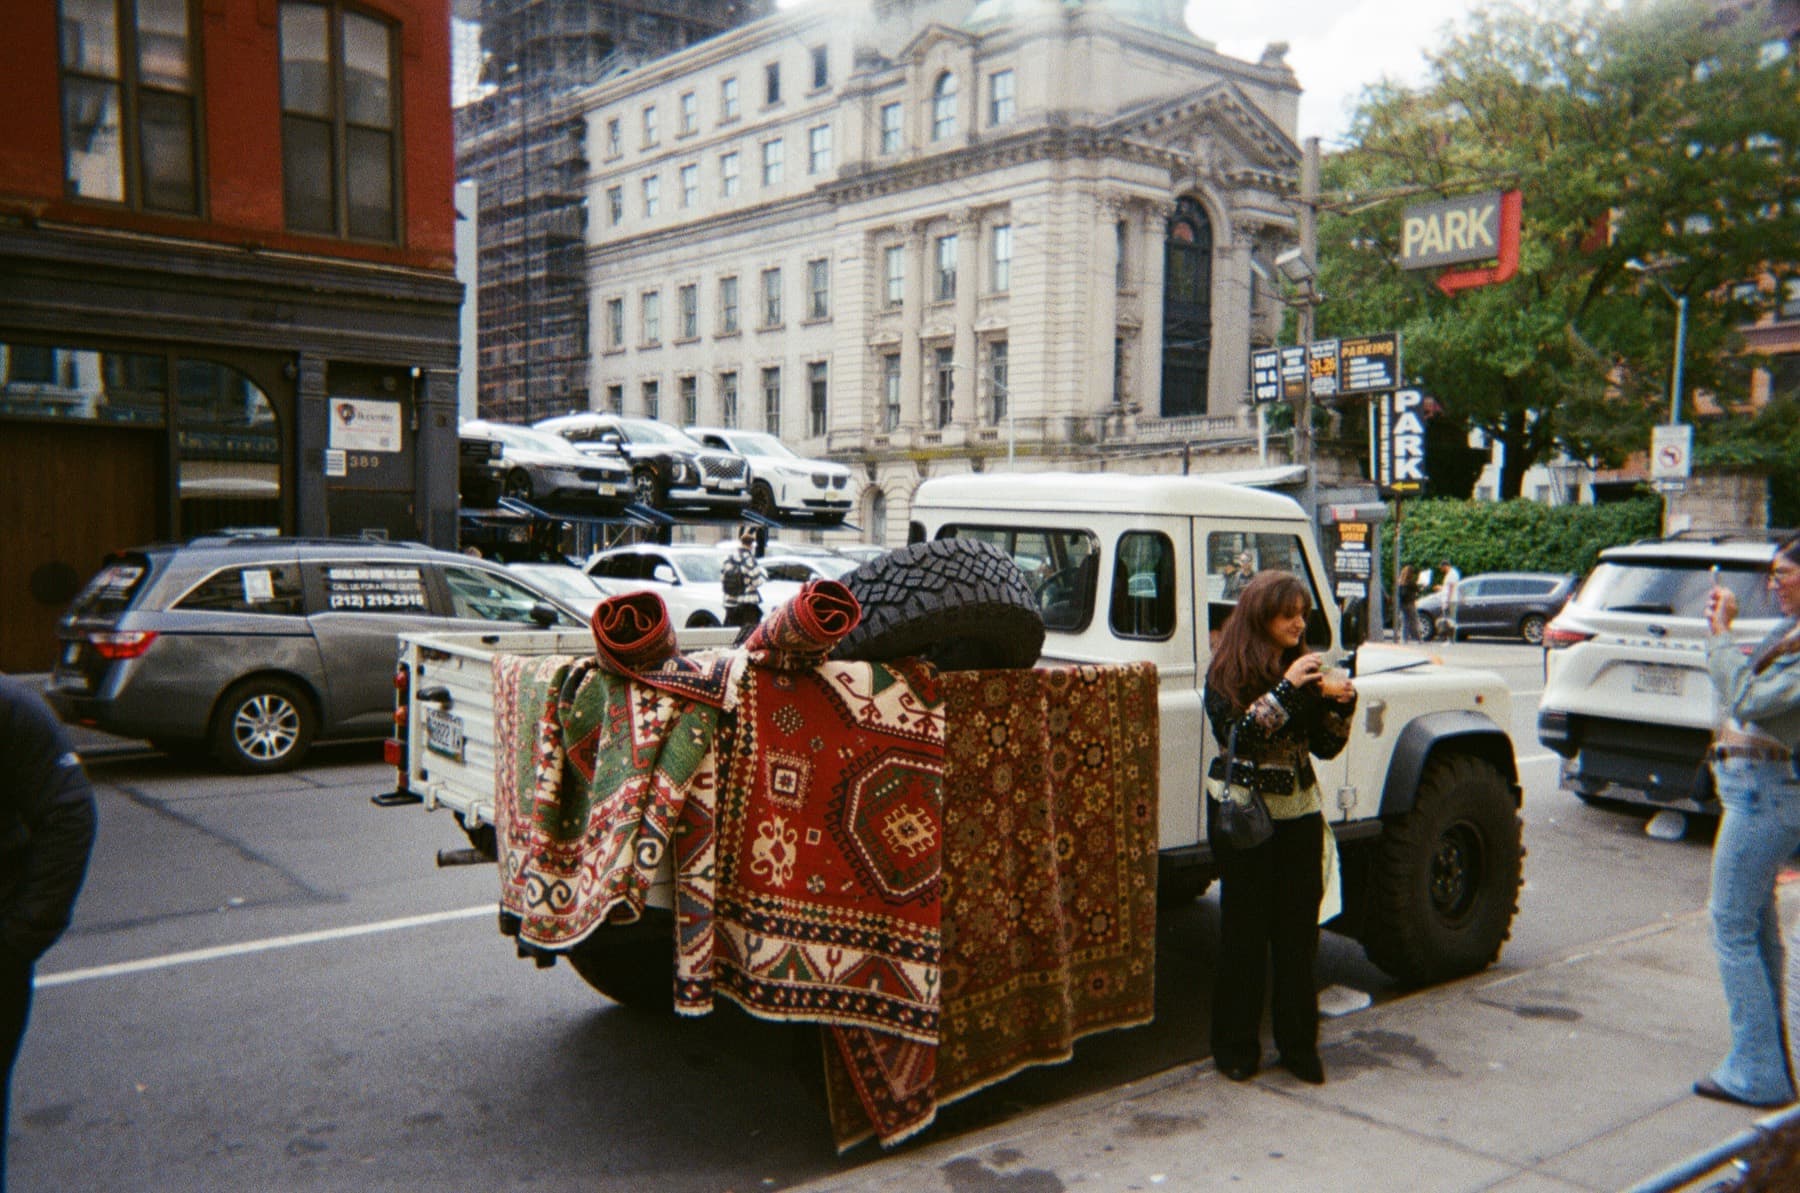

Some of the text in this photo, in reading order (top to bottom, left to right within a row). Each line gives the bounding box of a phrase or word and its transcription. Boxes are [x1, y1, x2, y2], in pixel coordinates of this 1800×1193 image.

[1403, 204, 1494, 259] PARK
[1341, 341, 1394, 358] PARKING
[1255, 369, 1277, 384] IN &
[1257, 385, 1277, 399] OUT
[1394, 390, 1424, 479] PARK
[350, 455, 379, 468] 389
[330, 594, 365, 608] (212)
